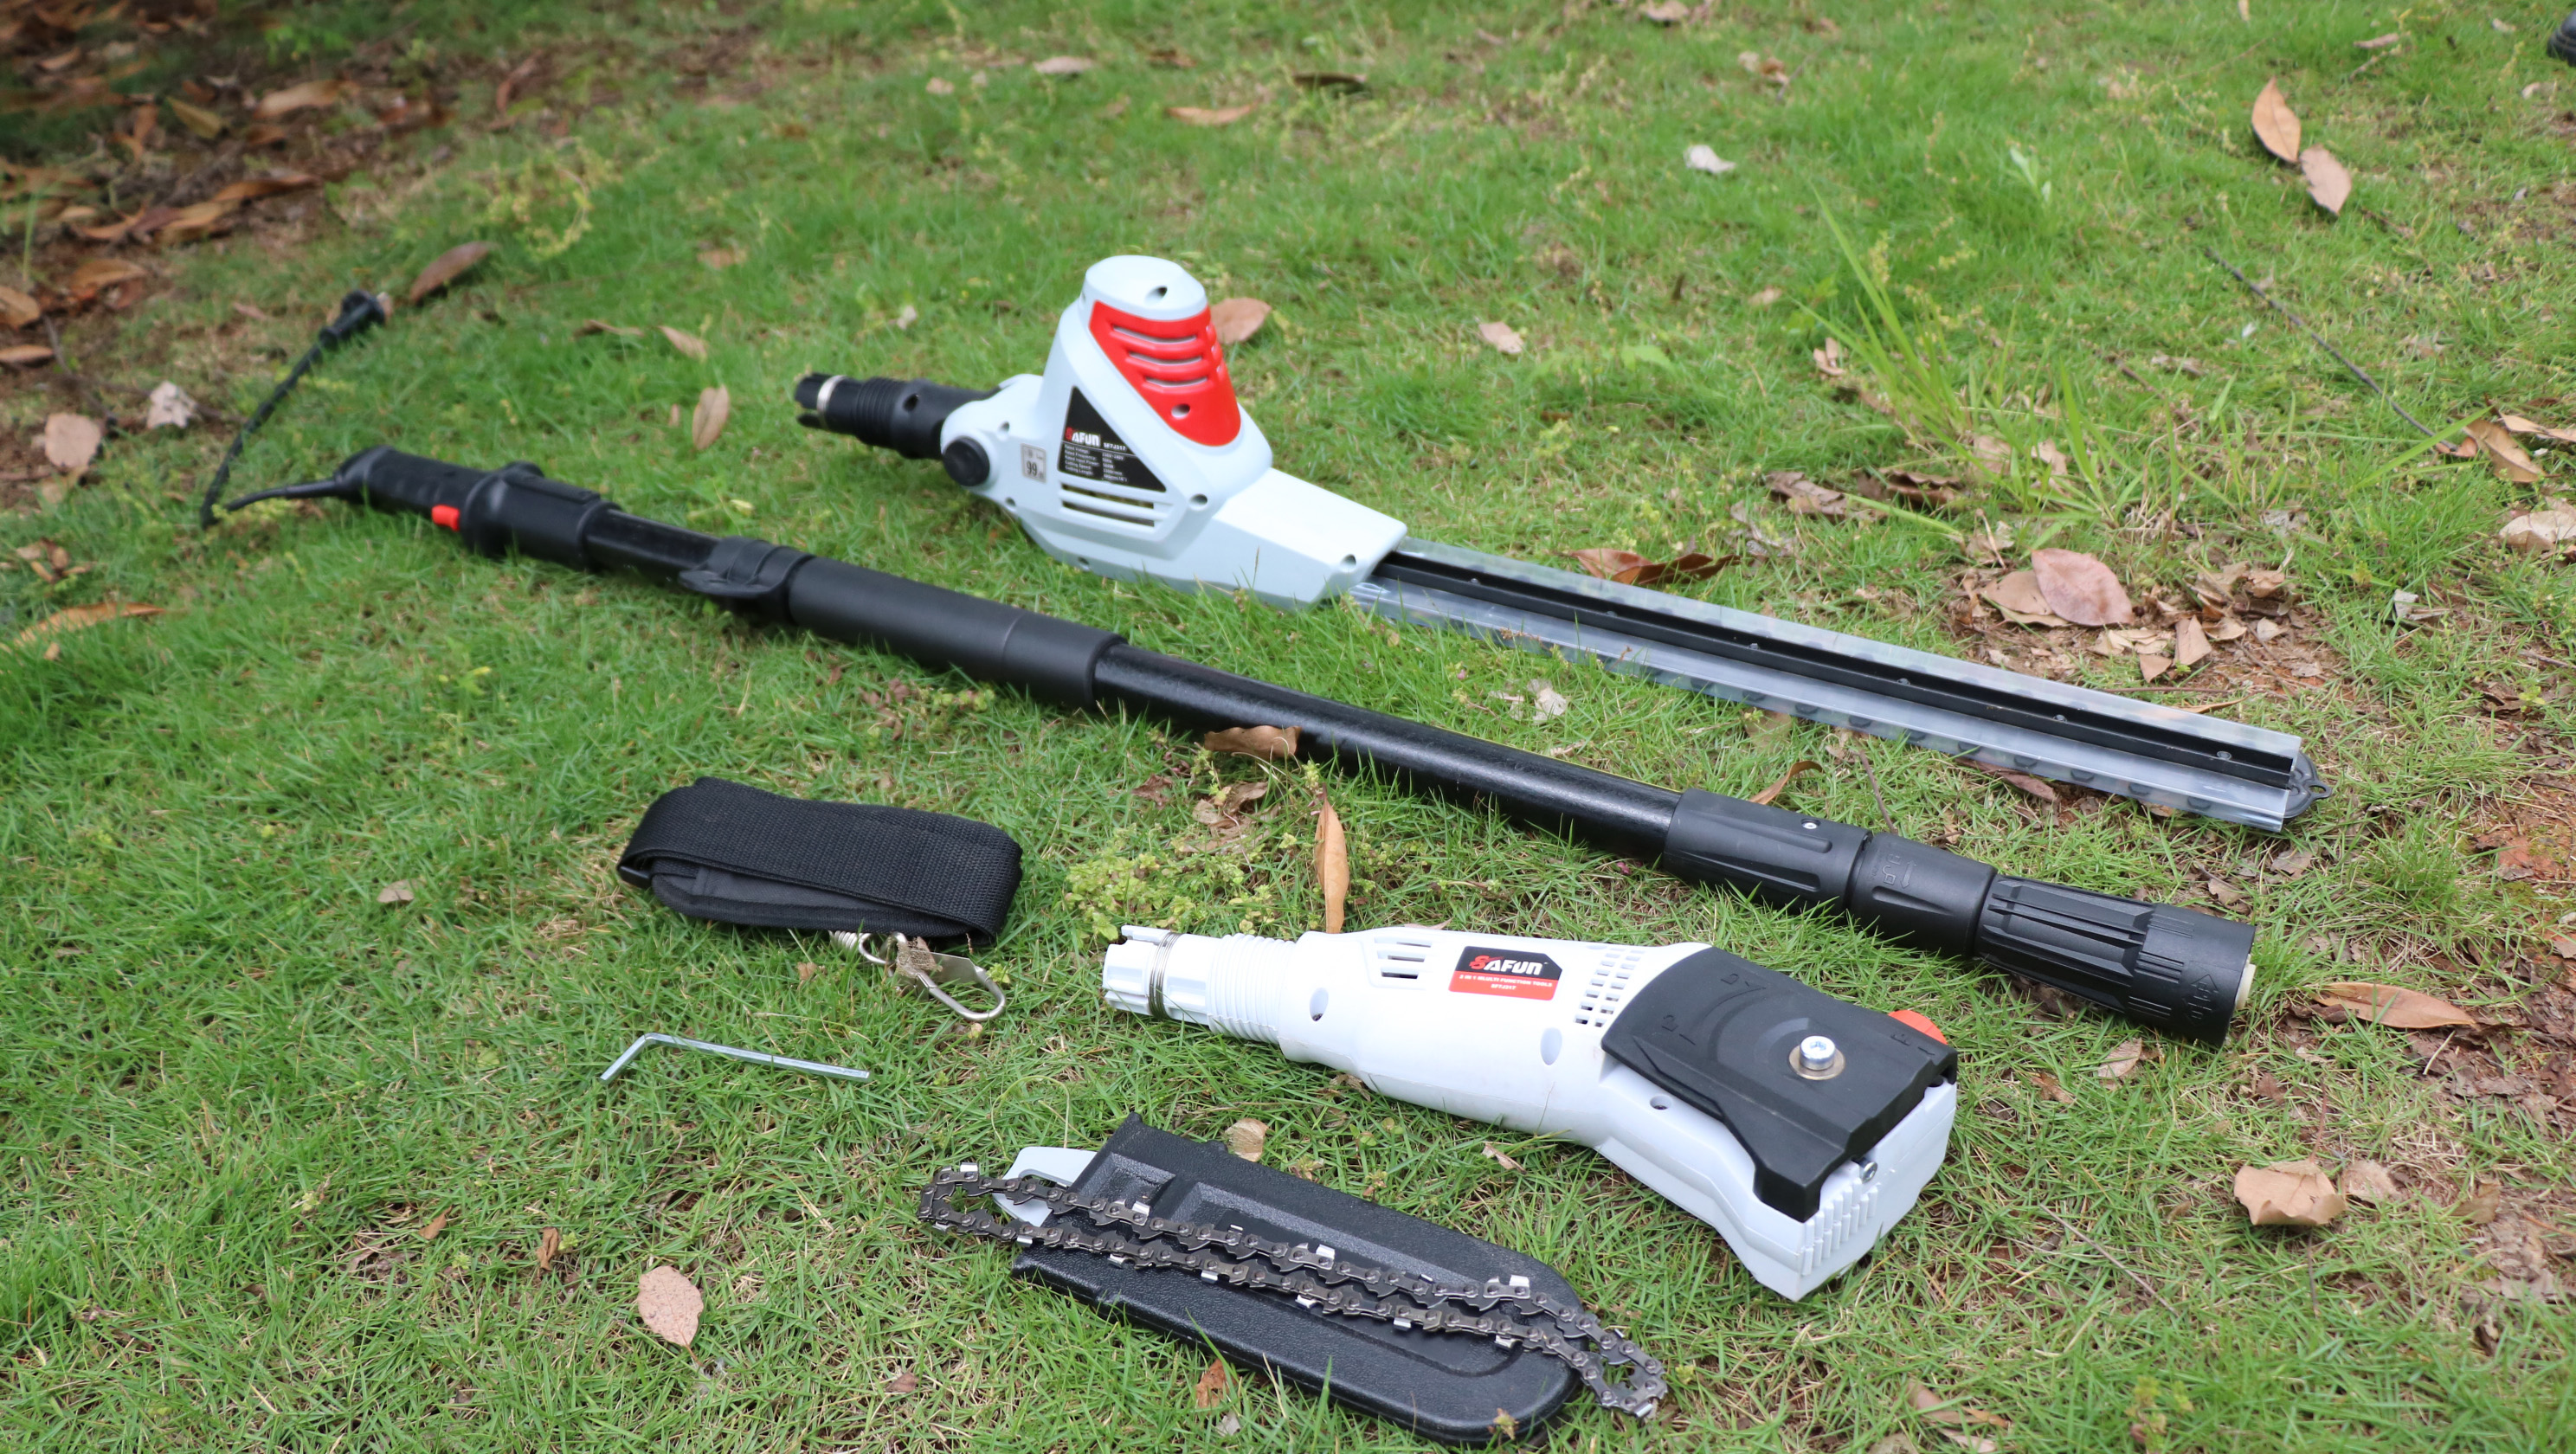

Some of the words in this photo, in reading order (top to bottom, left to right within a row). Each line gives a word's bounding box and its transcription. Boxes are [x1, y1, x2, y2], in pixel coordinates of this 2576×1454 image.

[1066, 427, 1100, 447] SAFUN
[1027, 460, 1038, 477] 99
[1469, 955, 1543, 975] SAFUN
